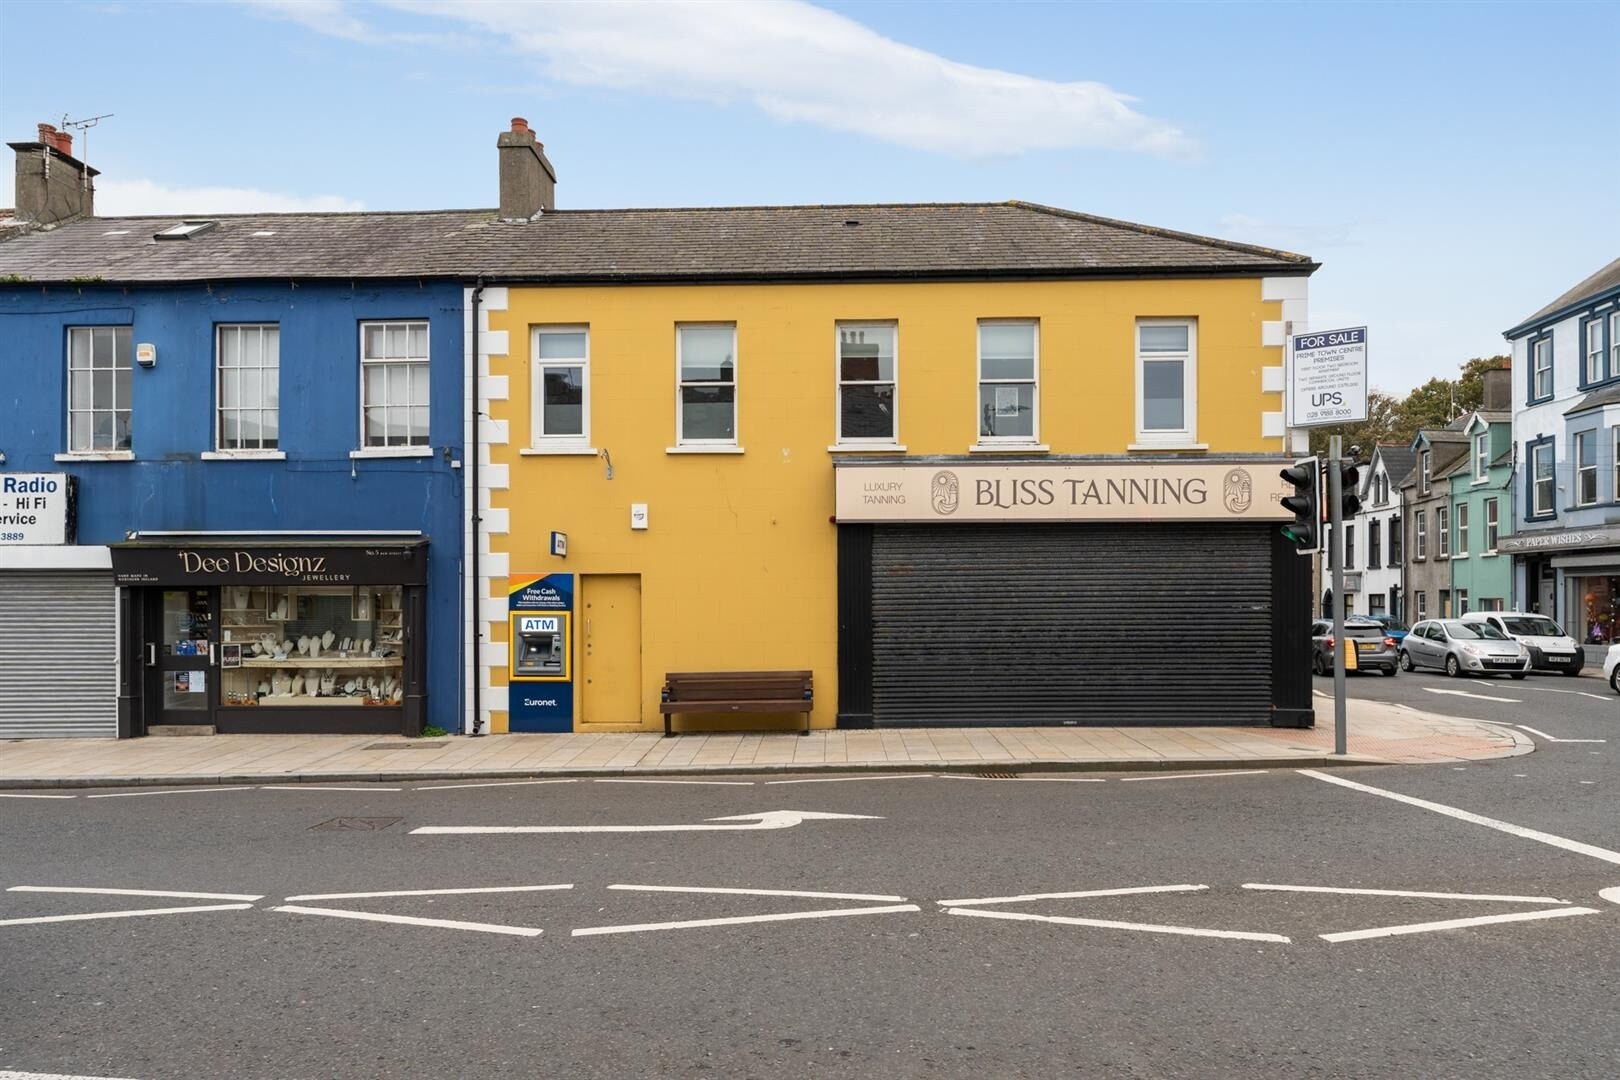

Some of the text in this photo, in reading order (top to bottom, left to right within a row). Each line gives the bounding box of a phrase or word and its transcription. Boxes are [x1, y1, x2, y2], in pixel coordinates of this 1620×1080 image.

[1301, 331, 1358, 349] FOR SALE
[1296, 346, 1363, 360] PRIME TOWN CENTRE
[1313, 355, 1344, 363] PREMISES
[1312, 391, 1342, 407] UPS
[4, 476, 57, 493] Radio
[863, 478, 1207, 508] LUXURY BLISS TANNING
[864, 494, 905, 505] TANNING
[16, 497, 29, 510] Hi
[34, 497, 47, 510] Fi
[1526, 533, 1582, 547] PAPER WISHES
[183, 551, 326, 577] Dee Designz
[302, 574, 351, 582] JEWELLERY
[525, 620, 554, 629] ATM
